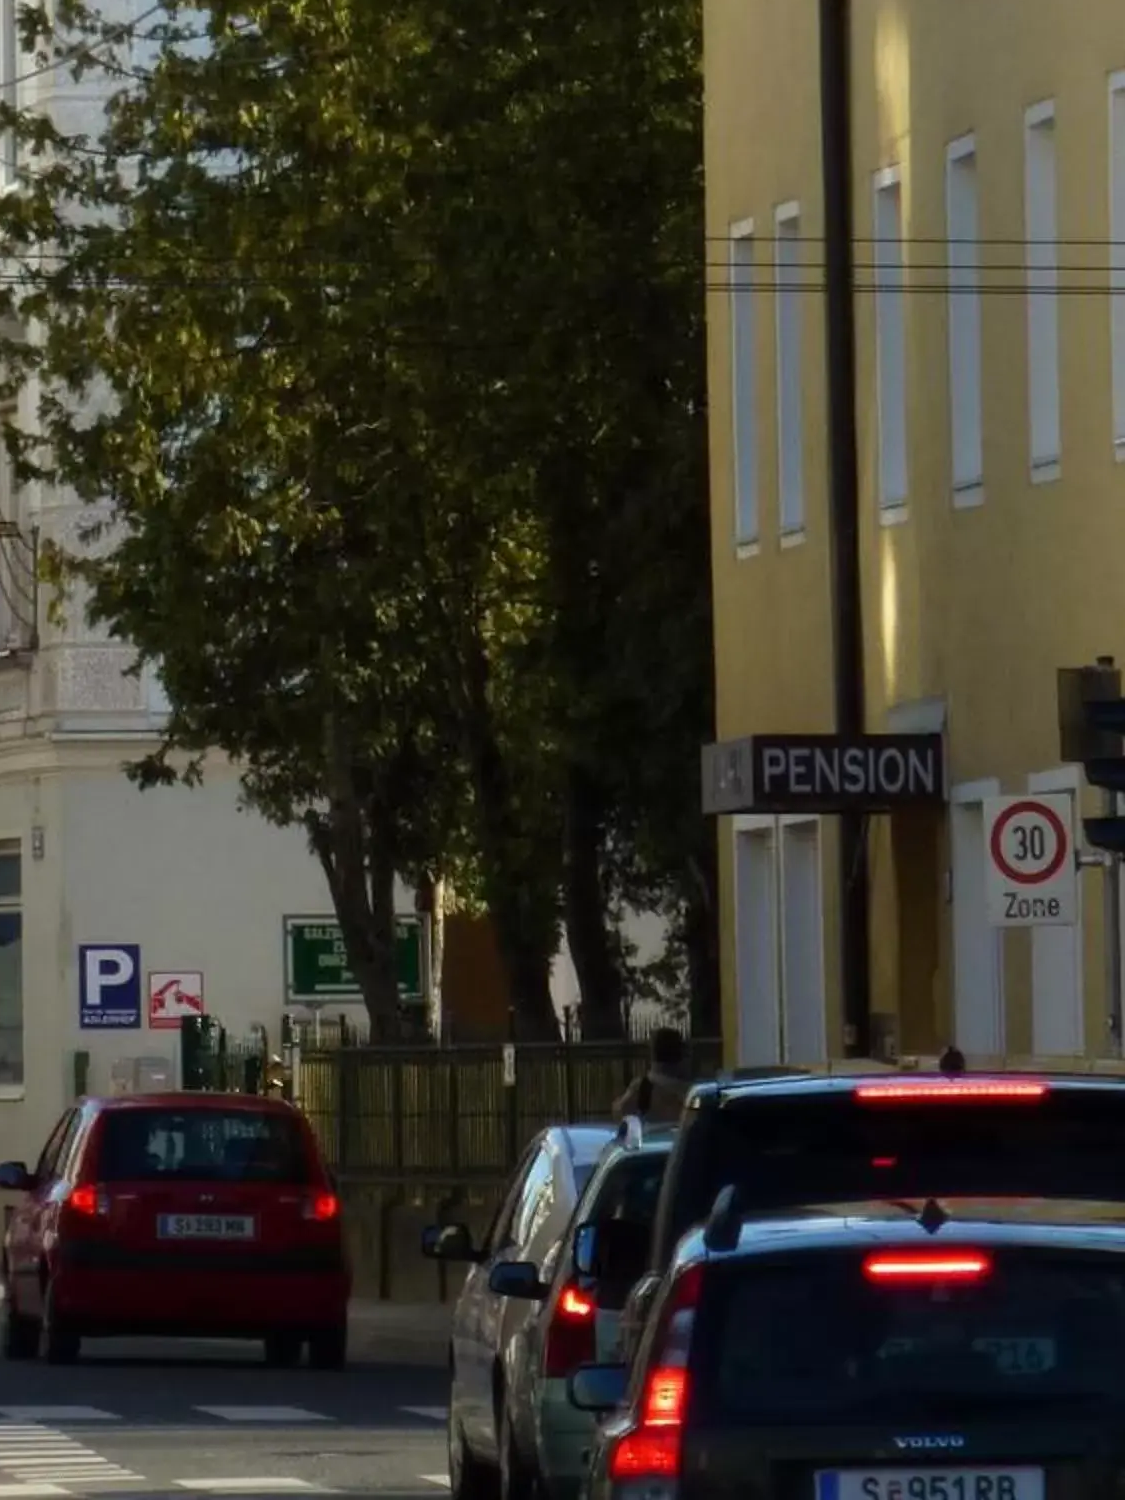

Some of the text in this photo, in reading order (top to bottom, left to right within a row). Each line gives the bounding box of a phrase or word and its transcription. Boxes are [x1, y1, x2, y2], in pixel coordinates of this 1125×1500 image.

[761, 747, 935, 794] PENSION
[1013, 826, 1045, 861] 30
[1003, 892, 1061, 918] Zone
[85, 948, 134, 1006] P
[893, 1436, 965, 1448] VOLVO
